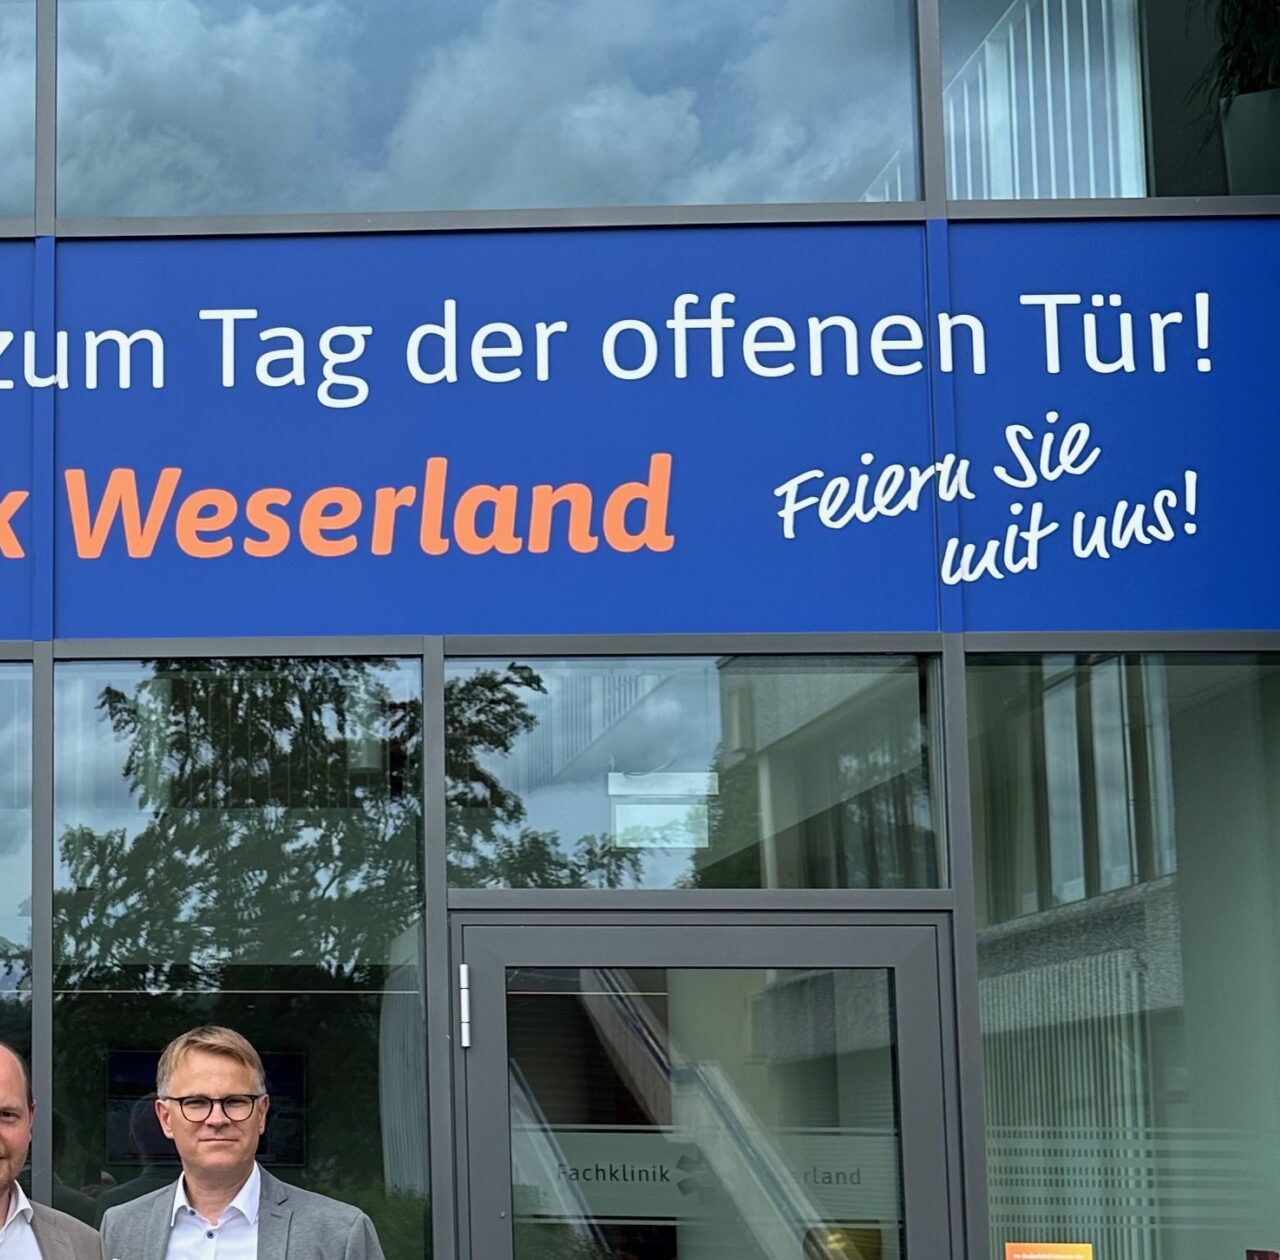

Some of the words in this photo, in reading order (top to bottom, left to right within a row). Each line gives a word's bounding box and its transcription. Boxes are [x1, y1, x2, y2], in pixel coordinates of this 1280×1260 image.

[198, 308, 374, 410] Tag
[405, 298, 569, 385] der
[601, 291, 987, 381] offenen
[1018, 292, 1212, 375] Tür!
[63, 451, 676, 560] Weserland
[772, 451, 977, 540] Feiern
[992, 410, 1102, 489] Sie
[940, 501, 1060, 586] mit
[1071, 469, 1198, 560] uns!
[557, 1162, 671, 1184] Fachklinik
[802, 1165, 863, 1186] rland
